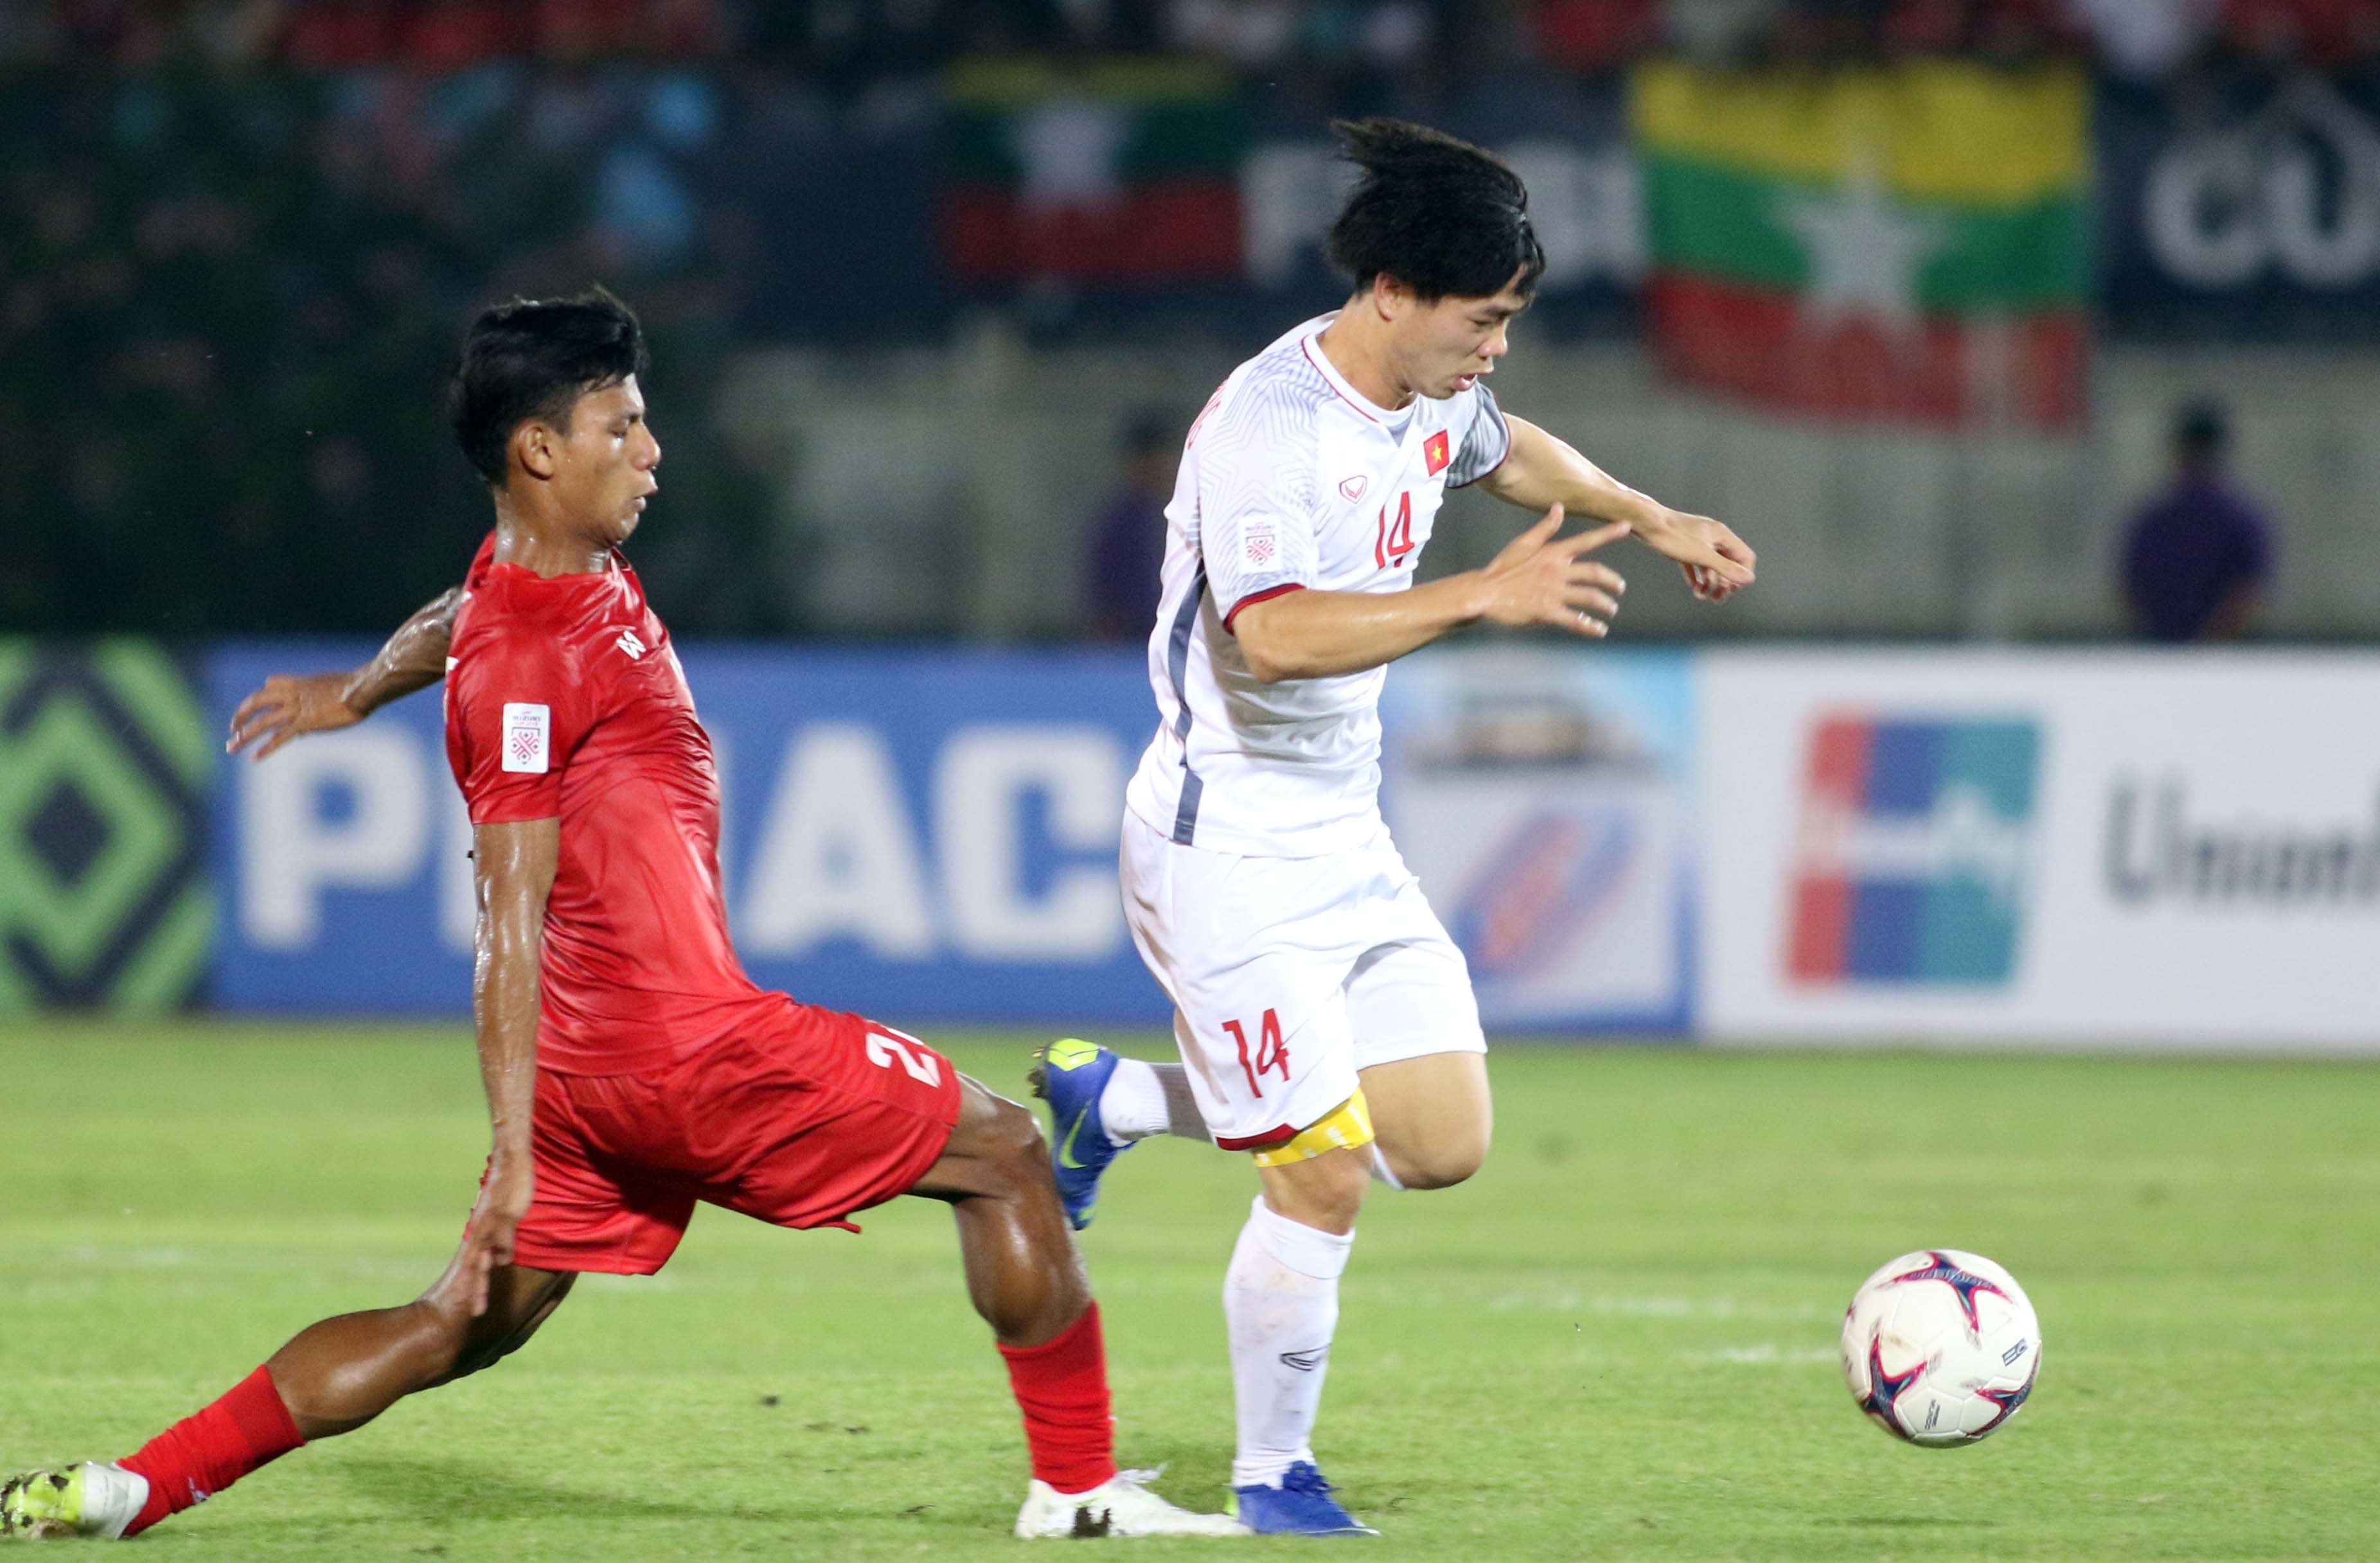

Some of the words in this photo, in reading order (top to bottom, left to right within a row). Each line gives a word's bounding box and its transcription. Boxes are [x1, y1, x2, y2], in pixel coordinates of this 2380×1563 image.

[1375, 491, 1415, 569] 14
[2106, 769, 2380, 903] Union
[1221, 1008, 1291, 1098] 14
